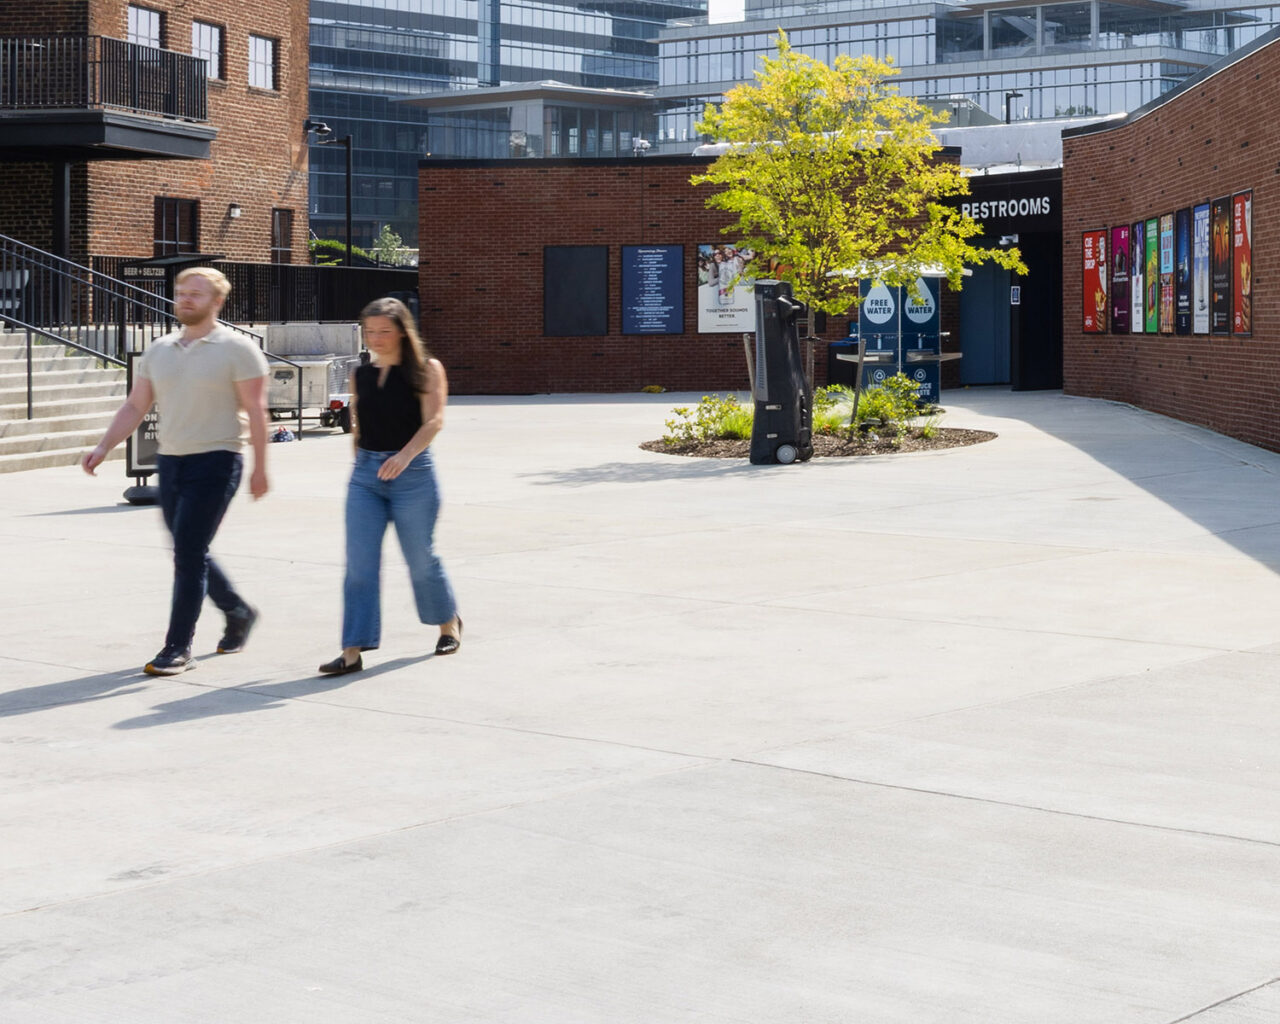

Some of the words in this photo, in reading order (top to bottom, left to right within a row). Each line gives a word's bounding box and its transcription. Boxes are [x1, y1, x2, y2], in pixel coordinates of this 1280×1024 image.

[961, 196, 1050, 219] RESTROOMS
[124, 267, 137, 276] BEER
[143, 267, 165, 276] SELTZER
[870, 299, 888, 307] FREE
[908, 306, 932, 314] WATER
